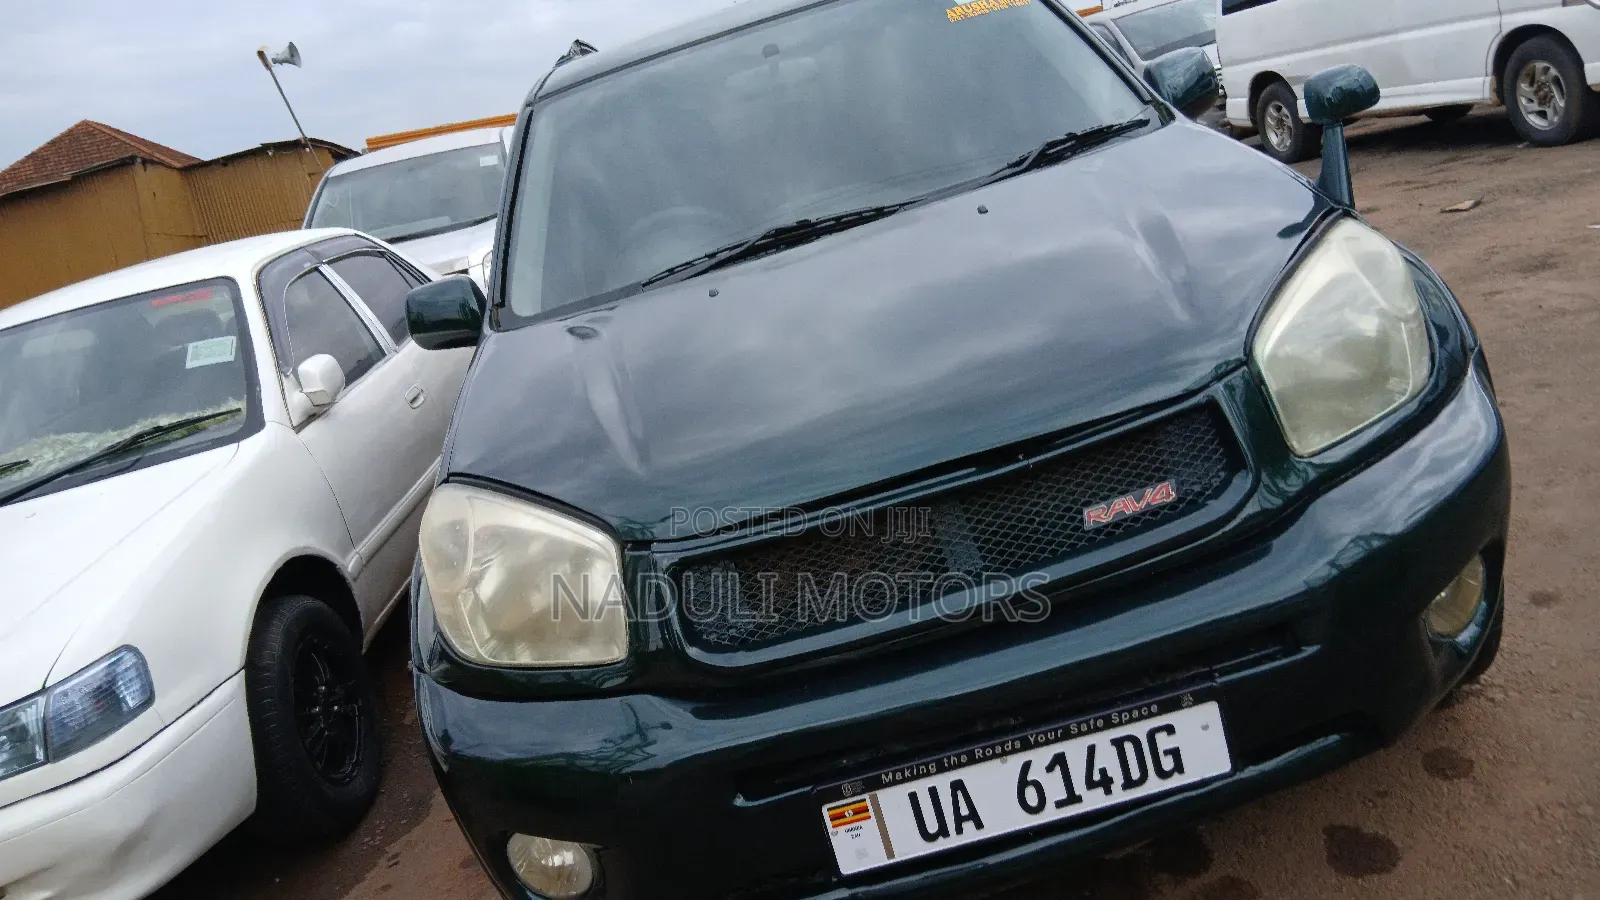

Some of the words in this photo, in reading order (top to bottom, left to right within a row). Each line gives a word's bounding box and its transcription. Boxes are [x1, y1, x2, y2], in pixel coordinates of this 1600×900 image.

[1085, 481, 1176, 526] RAV4
[881, 762, 937, 784] Making
[943, 753, 968, 767] the
[974, 740, 1021, 759] Roads
[1027, 728, 1063, 745] Your
[1070, 718, 1104, 735] Safe
[1111, 703, 1158, 724] Space
[908, 778, 985, 843] UA
[1016, 723, 1185, 815] 614DG
